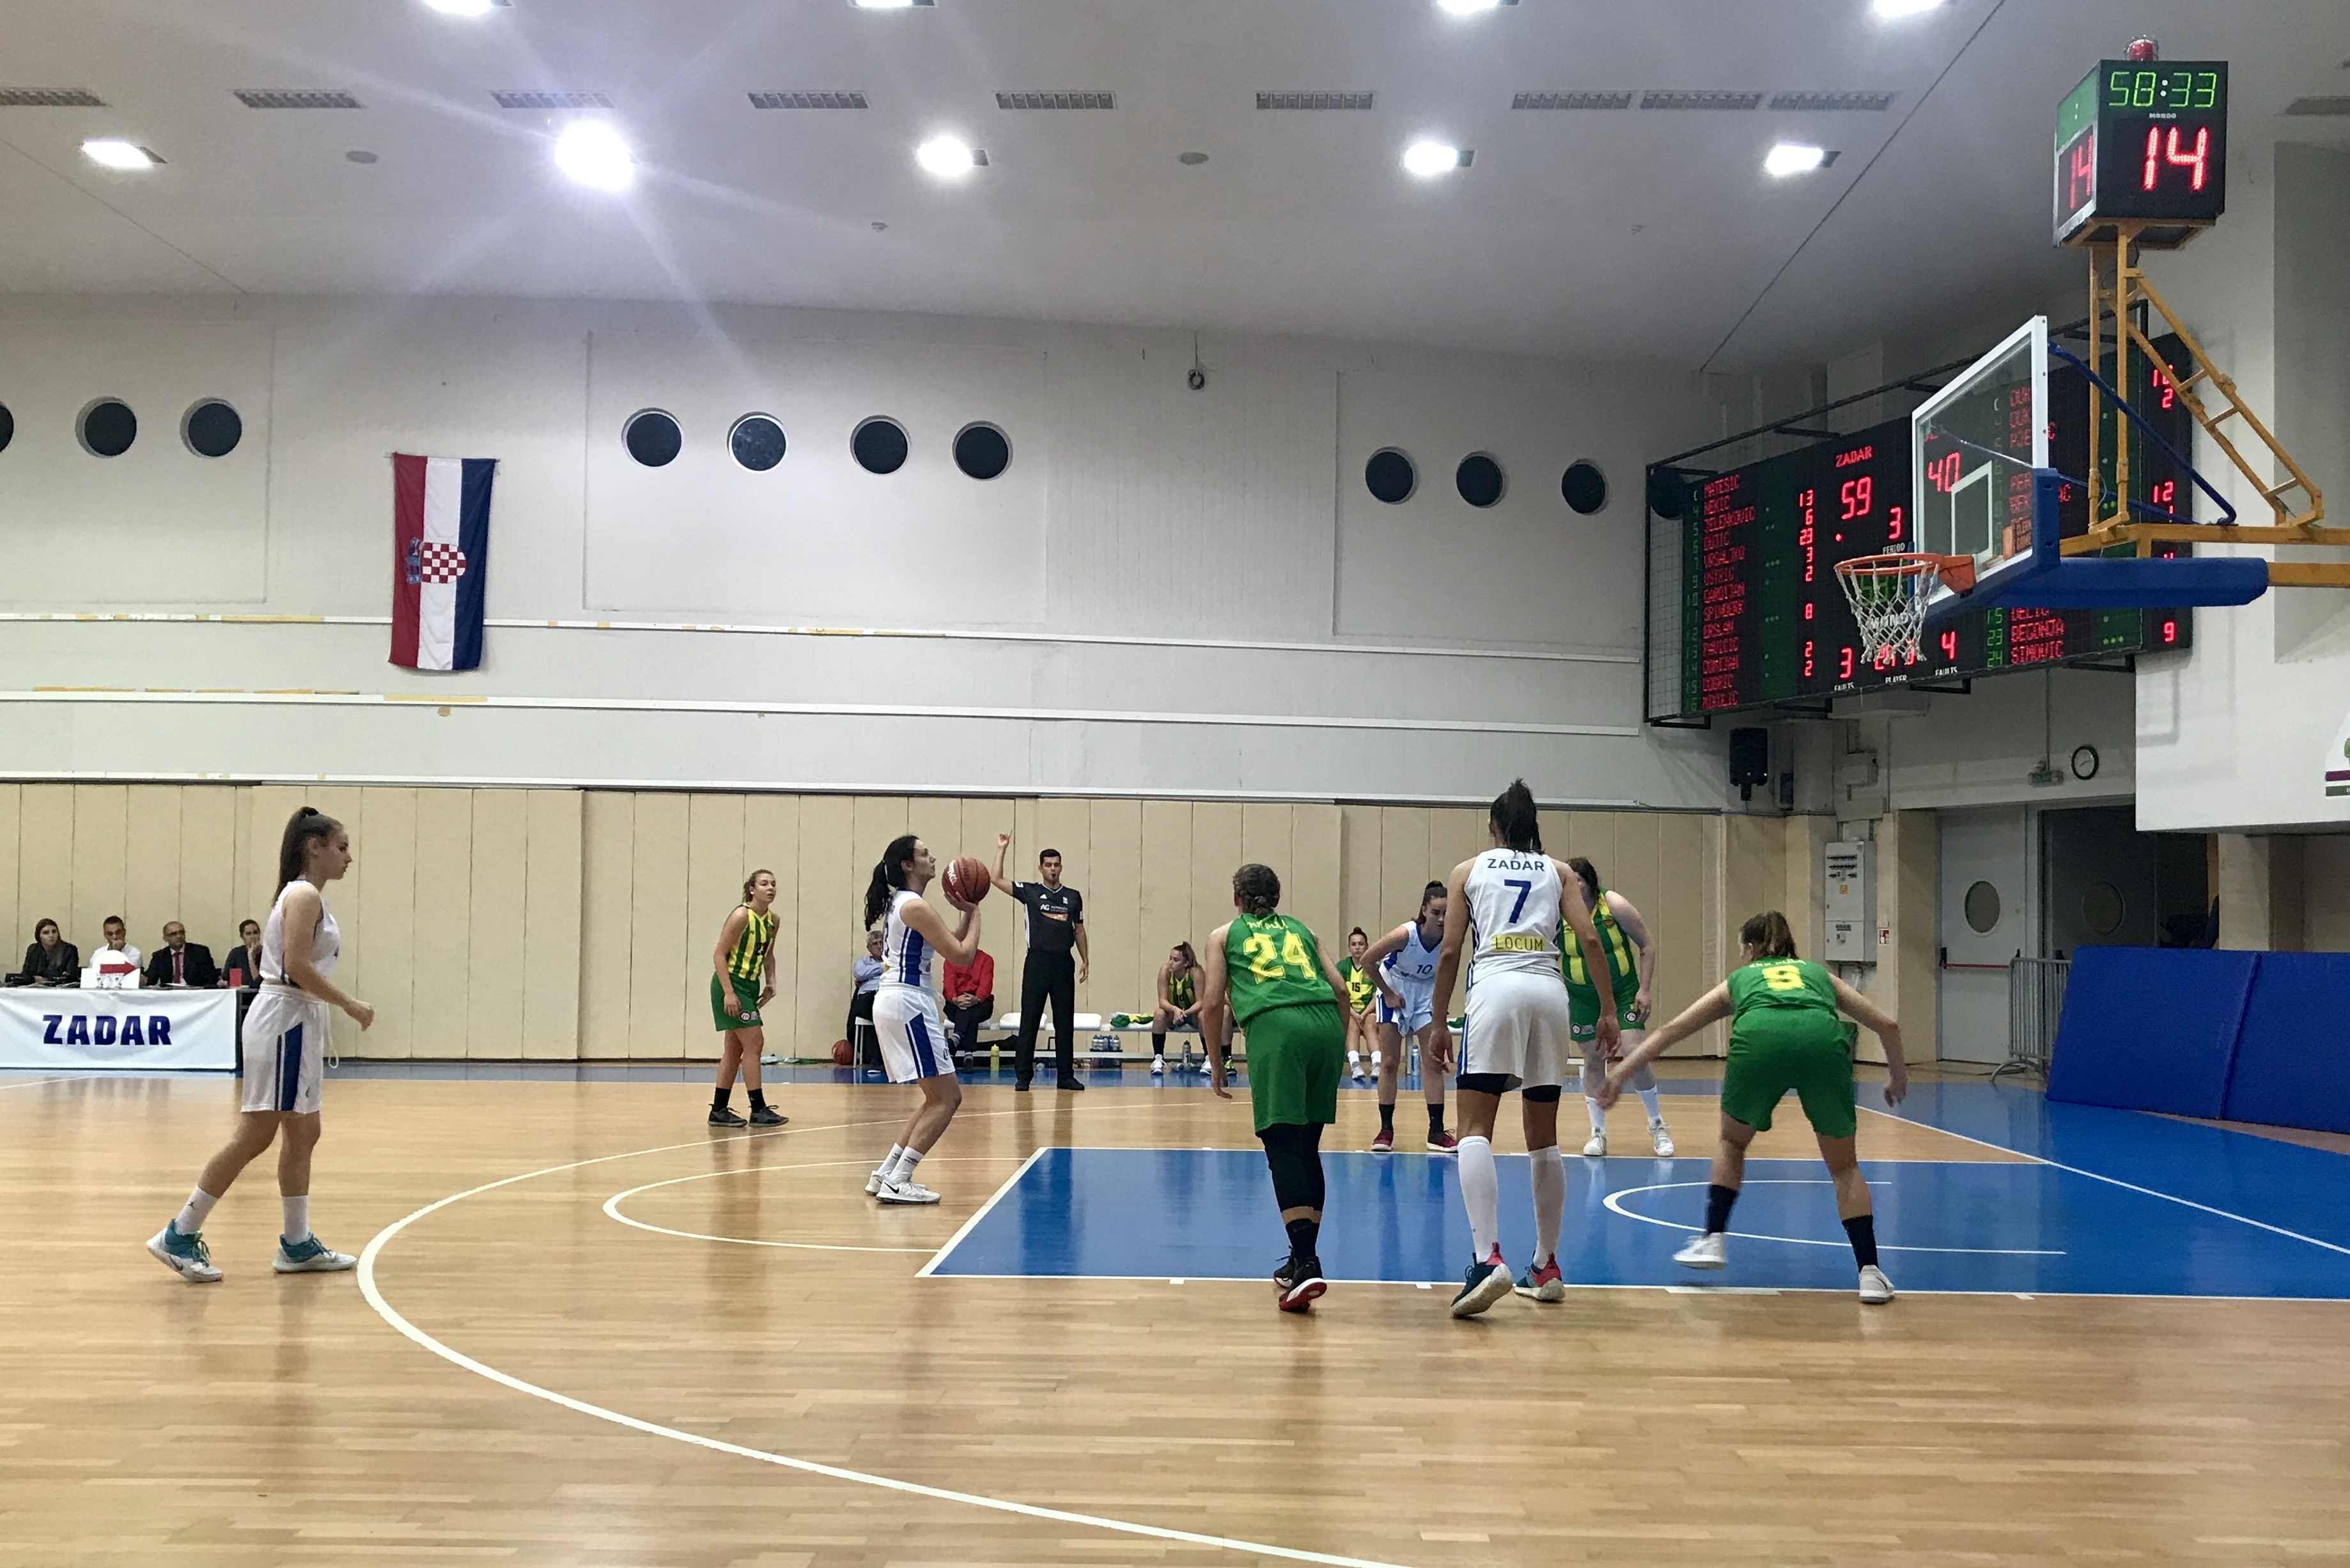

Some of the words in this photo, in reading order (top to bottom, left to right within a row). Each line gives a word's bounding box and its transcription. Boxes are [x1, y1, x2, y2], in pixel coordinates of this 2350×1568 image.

[2109, 71, 2217, 107] 58:33
[2142, 126, 2208, 191] 14
[2069, 134, 2094, 210] 14
[2162, 388, 2174, 408] 2
[1928, 451, 1960, 492] 40
[1800, 489, 1813, 508] 13
[1841, 477, 1871, 520] 59
[2153, 481, 2174, 504] 12
[1805, 508, 1813, 525] 6
[1888, 507, 1902, 539] 3
[1800, 527, 1813, 546] 23
[1805, 547, 1813, 563] 3
[1882, 542, 1906, 555] PERIOD
[1805, 566, 1813, 582] 2
[1987, 607, 2002, 625] 15
[1987, 628, 2002, 646] 23
[2164, 622, 2174, 642] 9
[1805, 640, 1813, 658] 2
[1941, 631, 1956, 660] 4
[1805, 660, 1813, 676] 2
[1840, 648, 1853, 678] 3
[1987, 650, 2002, 668] 24
[1885, 674, 1908, 684] PLAYER
[1487, 858, 1545, 872] ZADAR
[1040, 903, 1050, 912] AG
[1504, 879, 1532, 924] 7
[1495, 937, 1543, 952] LOCUM
[1243, 932, 1317, 984] 24
[1416, 964, 1433, 974] 10
[1762, 965, 1806, 991] 8
[1351, 982, 1360, 992] 15
[43, 1014, 172, 1046] ZADAR
